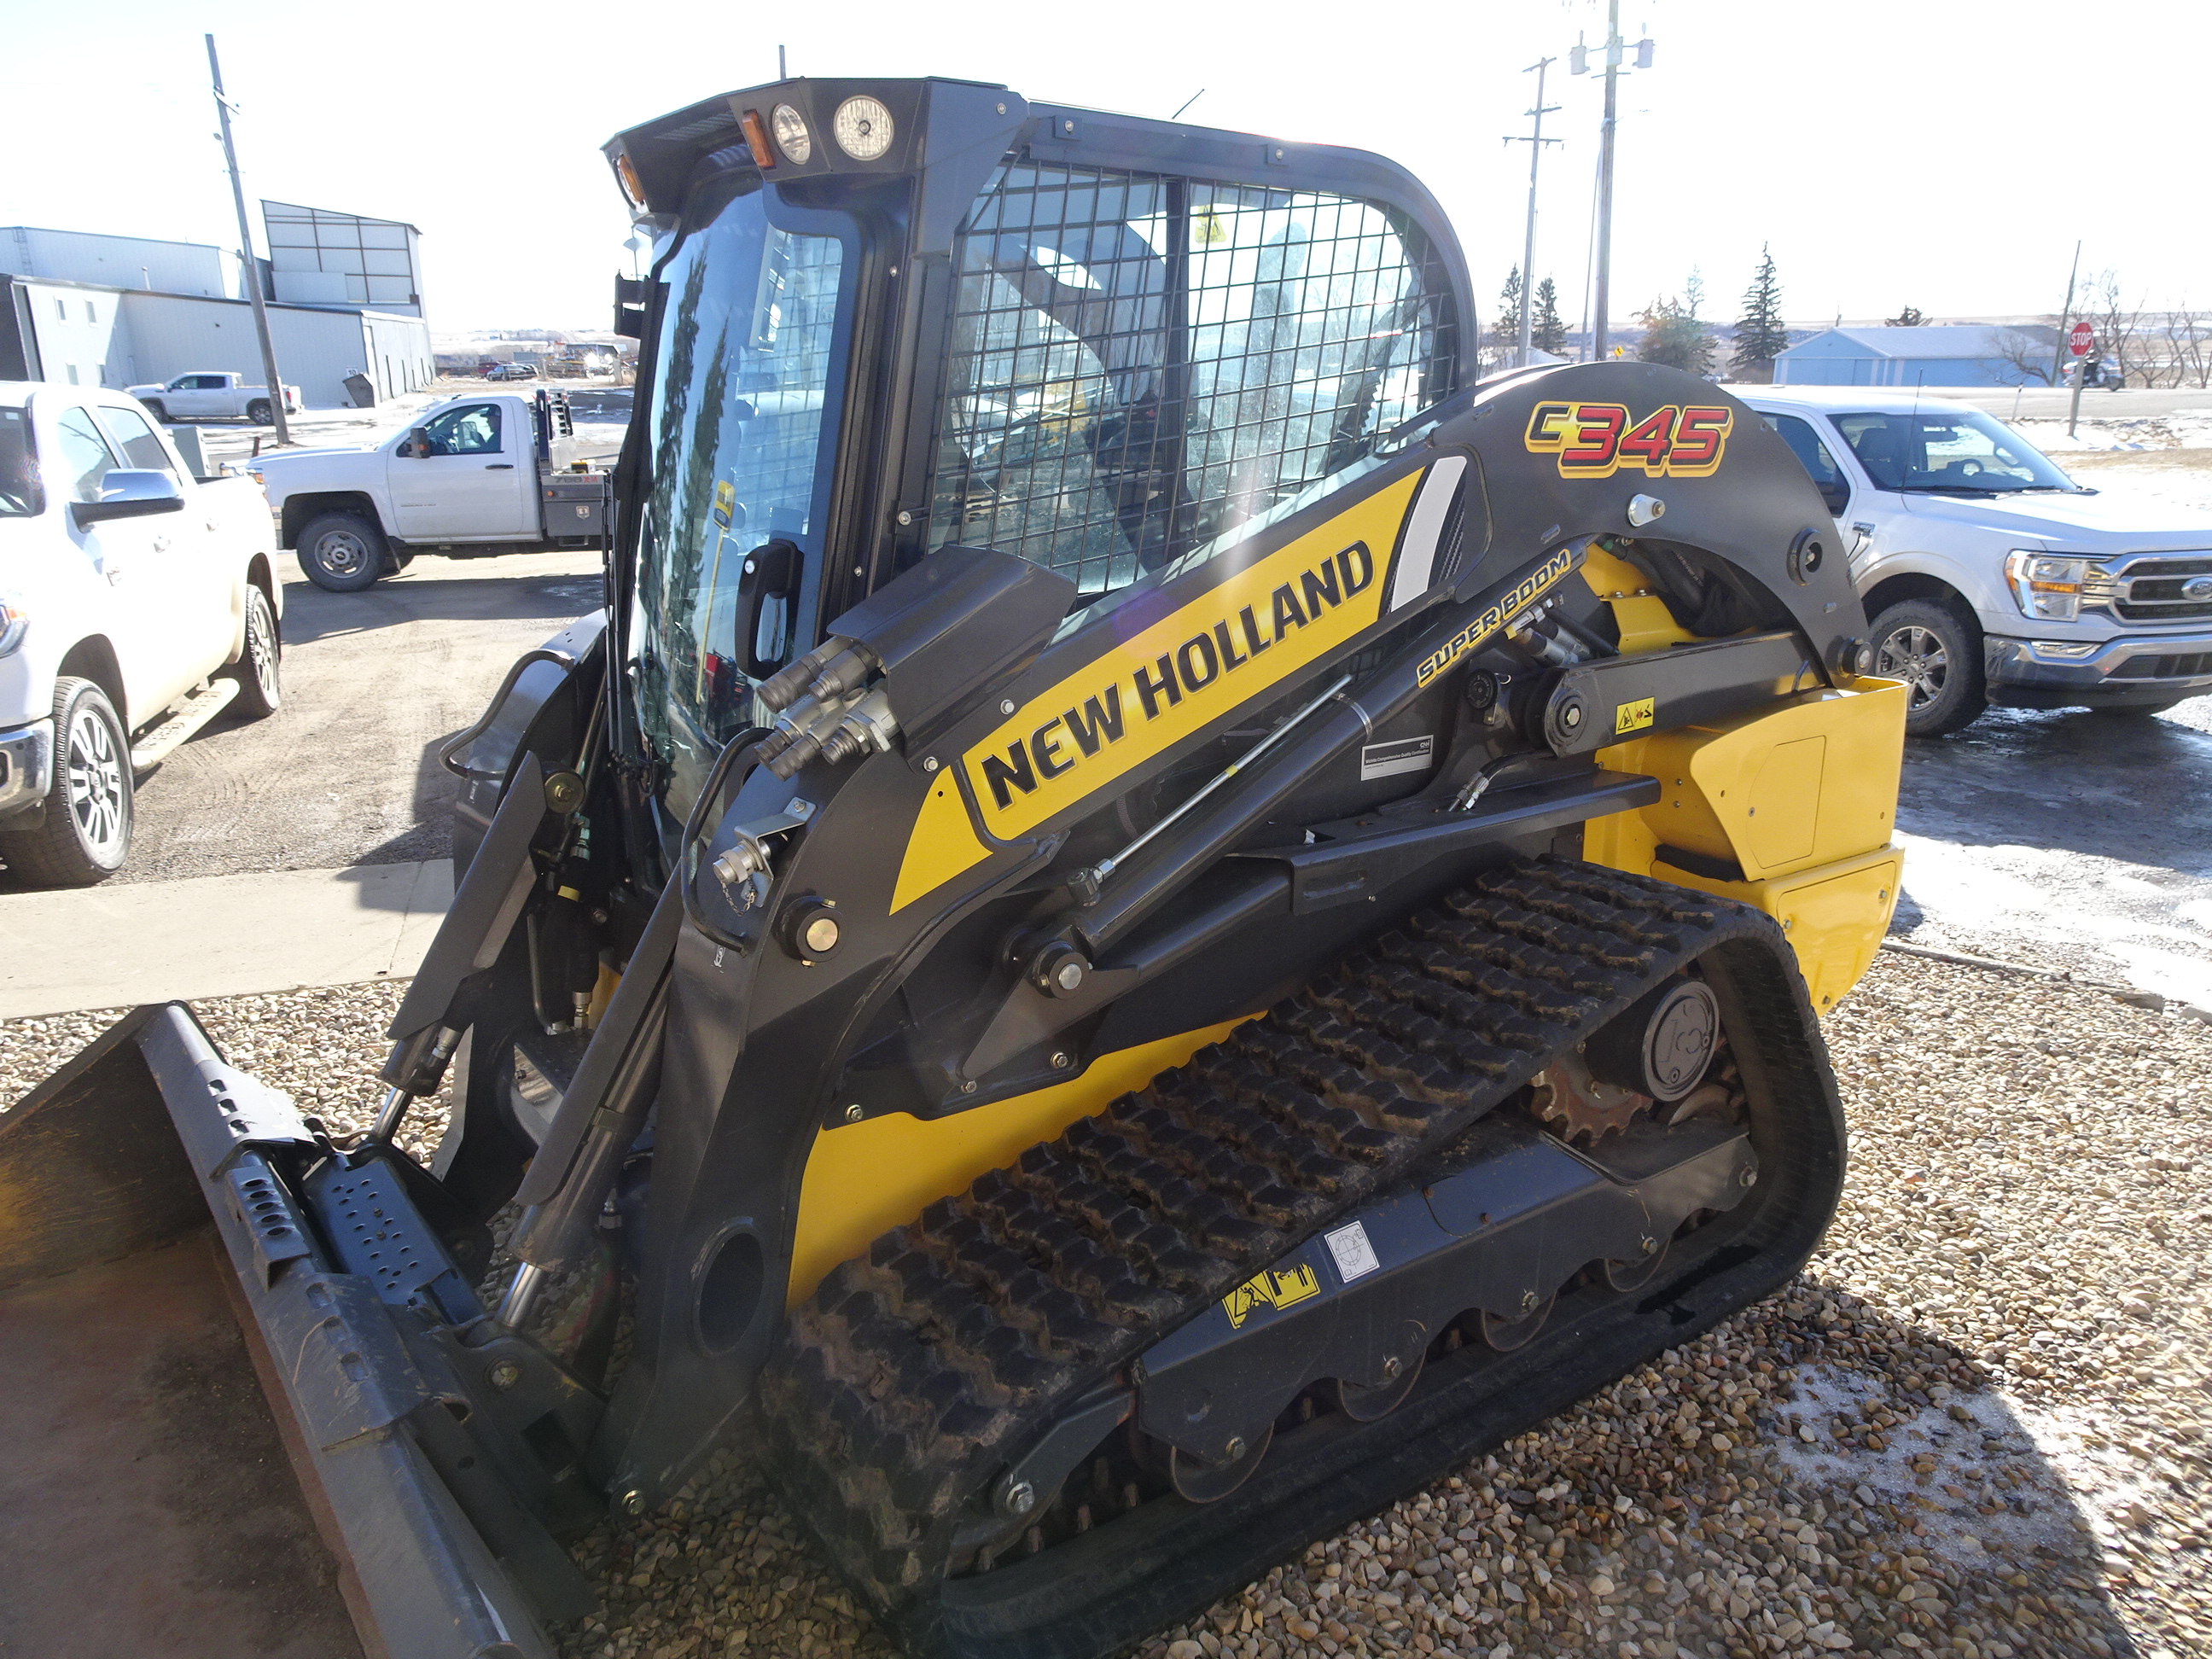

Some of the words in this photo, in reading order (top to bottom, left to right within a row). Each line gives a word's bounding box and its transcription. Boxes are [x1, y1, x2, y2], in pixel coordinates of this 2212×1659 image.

[2070, 332, 2092, 346] STOP
[1525, 402, 1733, 478] C345
[1417, 607, 1501, 688] SUPER
[1500, 549, 1572, 620] BOOM
[981, 682, 1125, 812] NEW
[1132, 538, 1376, 722] HOLLAND
